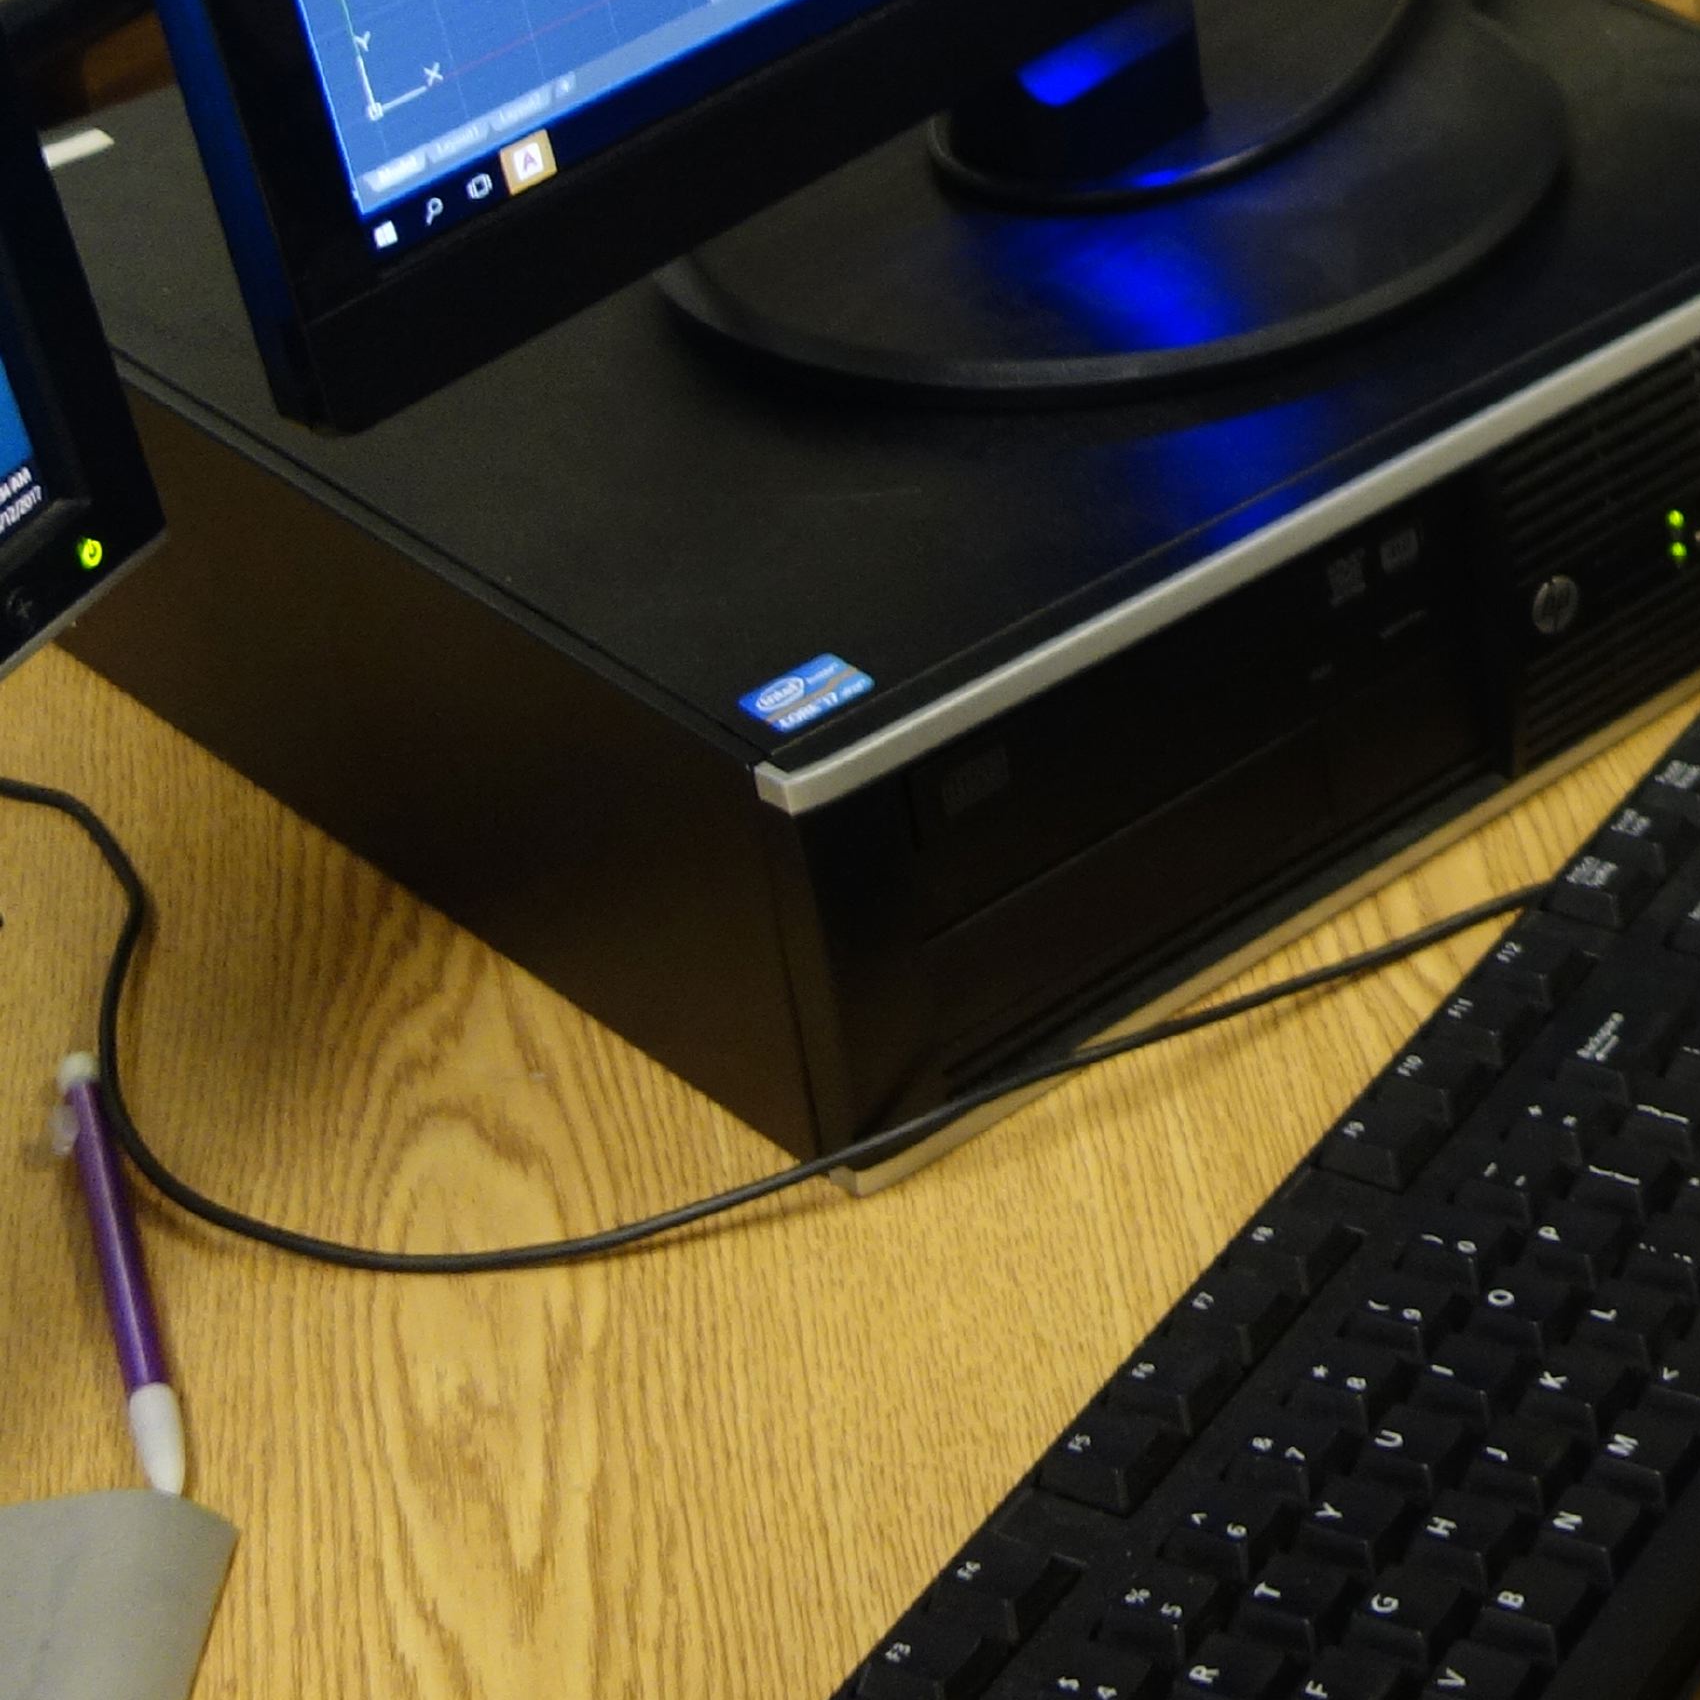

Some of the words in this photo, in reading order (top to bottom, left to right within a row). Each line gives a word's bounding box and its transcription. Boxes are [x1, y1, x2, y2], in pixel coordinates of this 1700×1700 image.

[423, 62, 444, 87] X
[8, 467, 32, 494] AM
[1447, 997, 1475, 1019] F11
[1396, 1054, 1425, 1077] F10
[1538, 1225, 1560, 1242] P
[1488, 1290, 1514, 1305] O
[1402, 1307, 1423, 1323] 9
[1590, 1308, 1617, 1324] L
[1540, 1372, 1566, 1388] K
[1375, 1430, 1402, 1447] U
[1608, 1434, 1637, 1455] M
[1284, 1446, 1306, 1462] 7
[1487, 1447, 1507, 1461] J
[1314, 1502, 1344, 1520] Y
[1427, 1517, 1456, 1536] H
[1553, 1512, 1582, 1530] N
[1226, 1522, 1249, 1540] 6
[957, 1562, 980, 1579] F4
[1254, 1582, 1280, 1597] T
[1372, 1594, 1398, 1612] G
[1498, 1592, 1524, 1608] B
[1160, 1602, 1184, 1619] 5
[885, 1643, 910, 1661] F3
[1189, 1666, 1218, 1683] R
[1438, 1668, 1465, 1686] V
[1306, 1681, 1327, 1698] F
